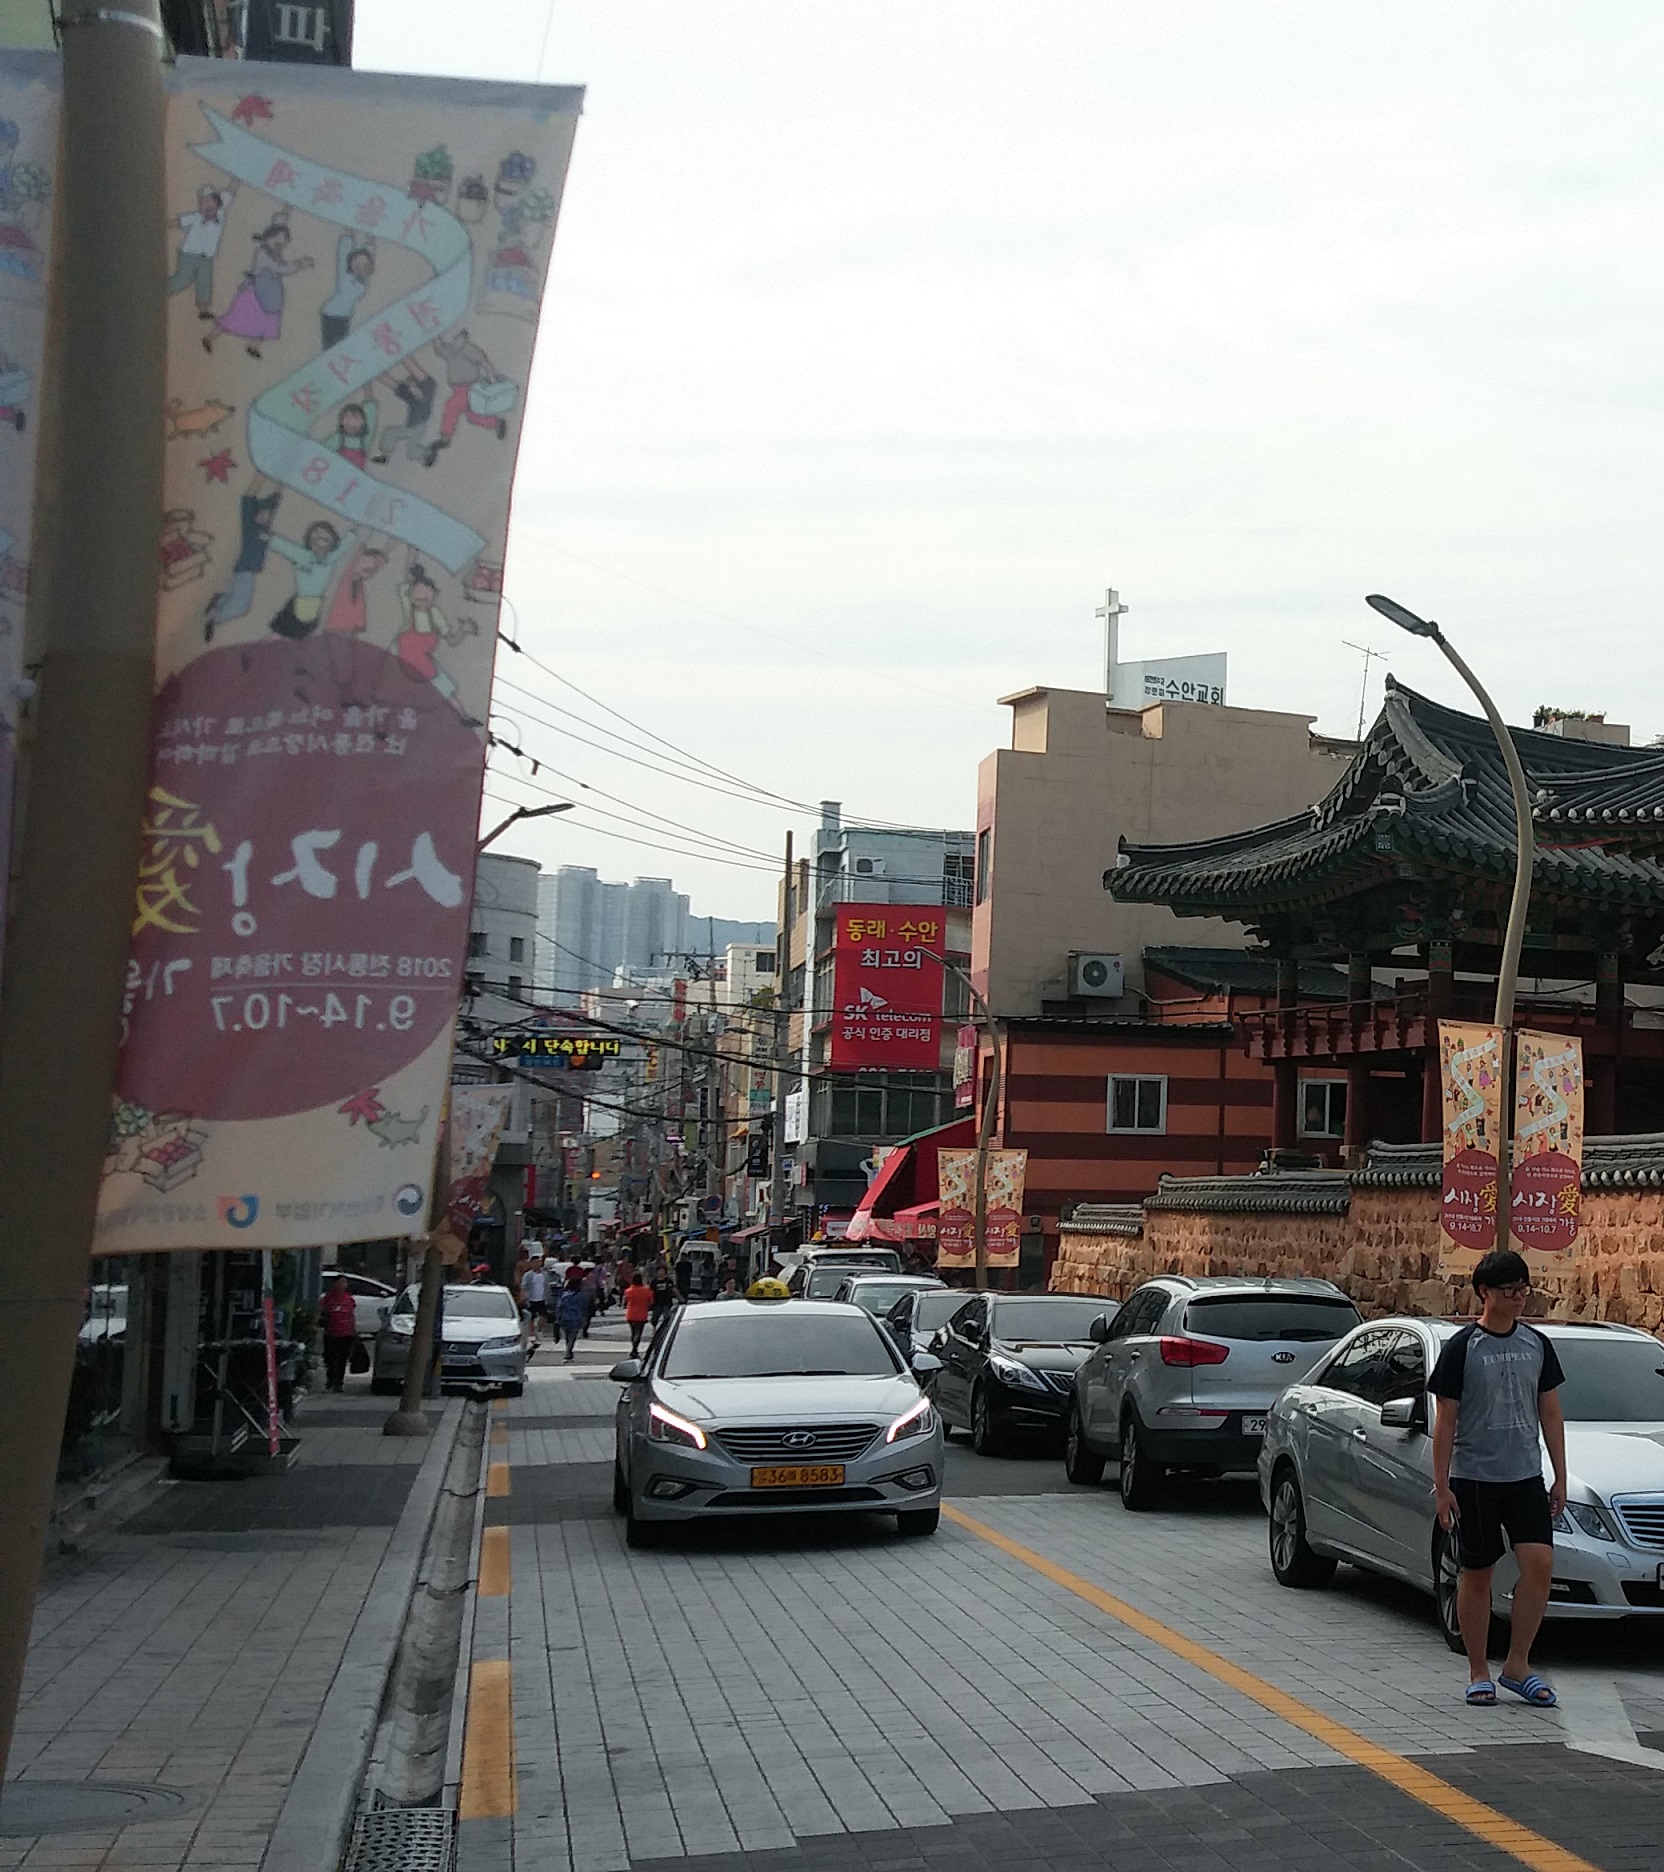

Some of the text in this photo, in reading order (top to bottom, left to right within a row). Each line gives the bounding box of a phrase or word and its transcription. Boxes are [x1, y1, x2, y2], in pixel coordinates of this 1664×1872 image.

[1166, 679, 1224, 706] 수안교회
[860, 948, 923, 969] 최고의
[843, 1004, 869, 1021] SK
[842, 1026, 931, 1042] 공식 인증 대리점
[1275, 1353, 1293, 1362] KIA
[800, 1468, 838, 1482] 8583
